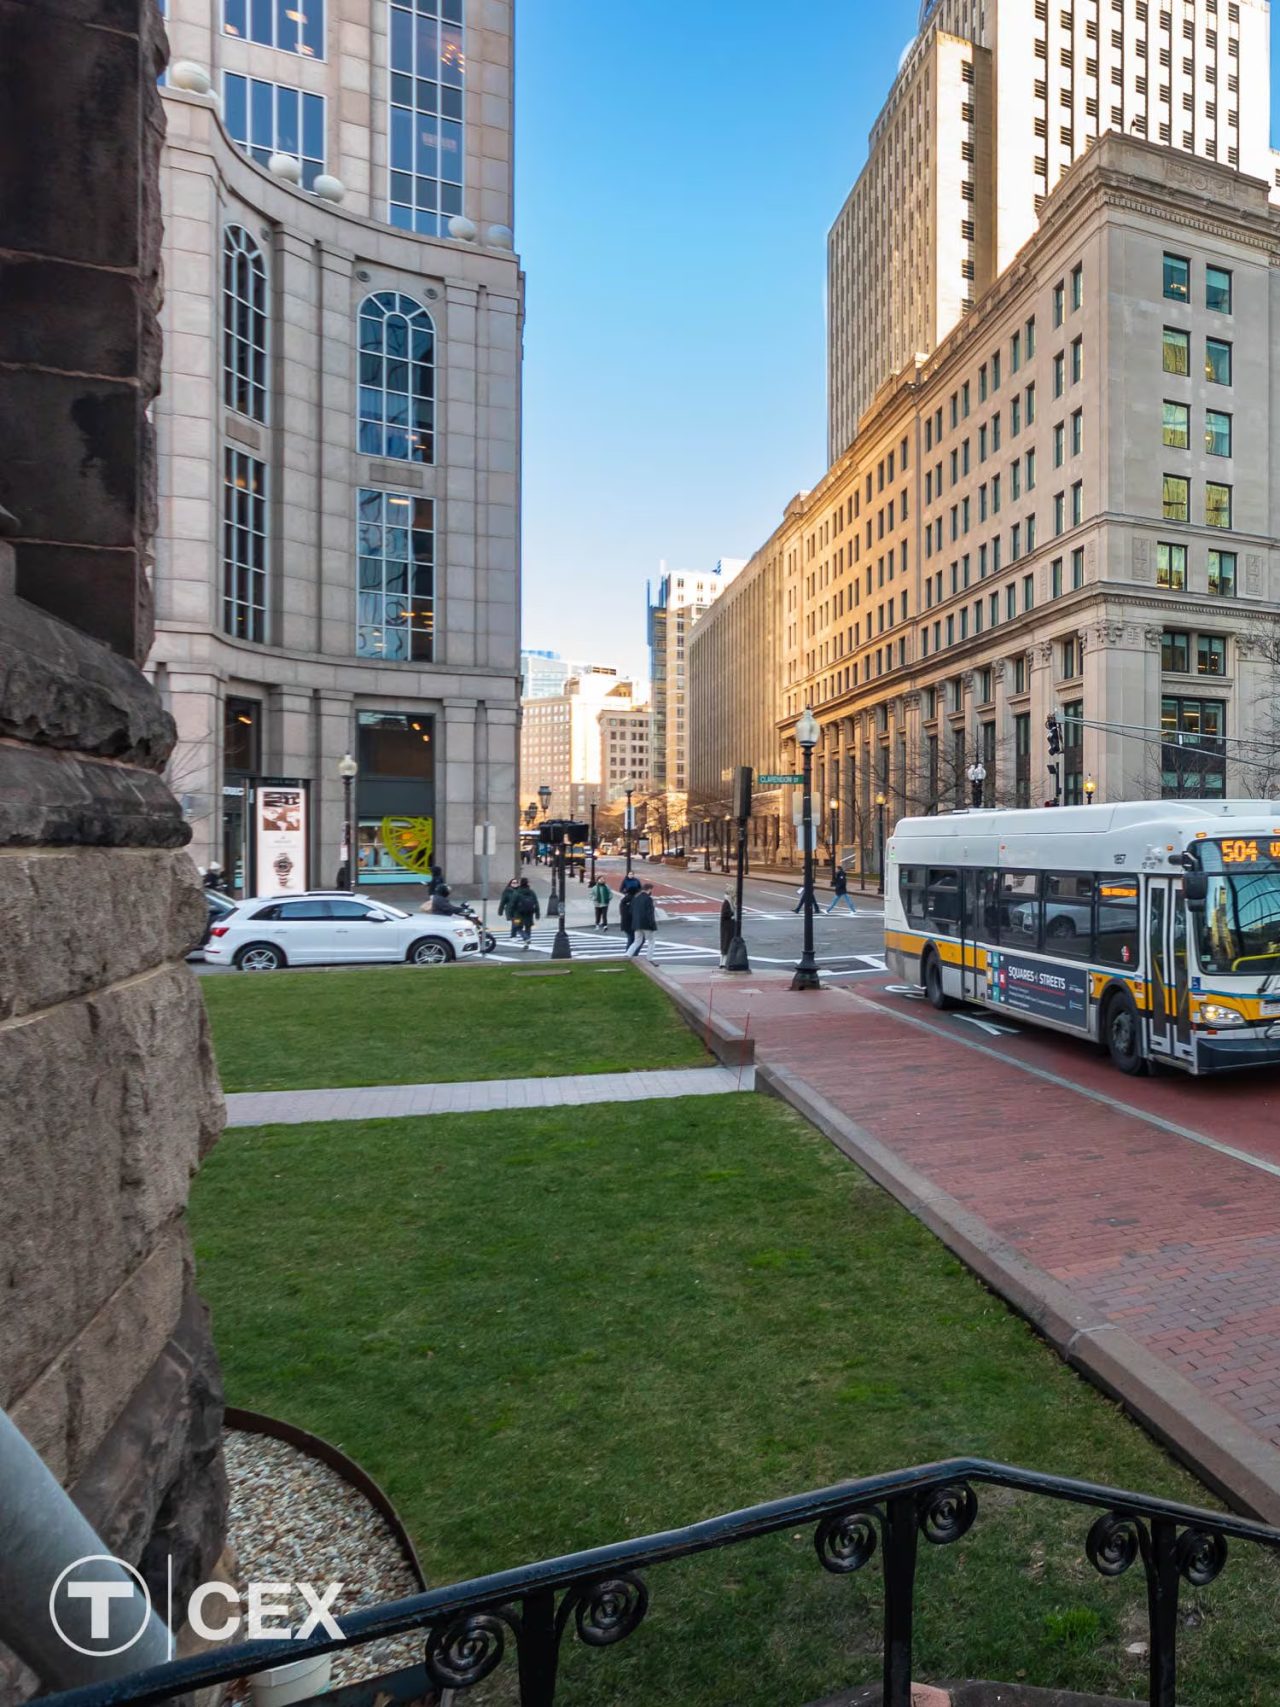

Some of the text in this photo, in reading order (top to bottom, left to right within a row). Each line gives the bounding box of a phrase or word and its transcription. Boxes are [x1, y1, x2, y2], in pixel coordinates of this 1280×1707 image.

[1221, 840, 1258, 862] 504
[1008, 965, 1035, 982] SQUARES
[1039, 973, 1066, 990] STREETS
